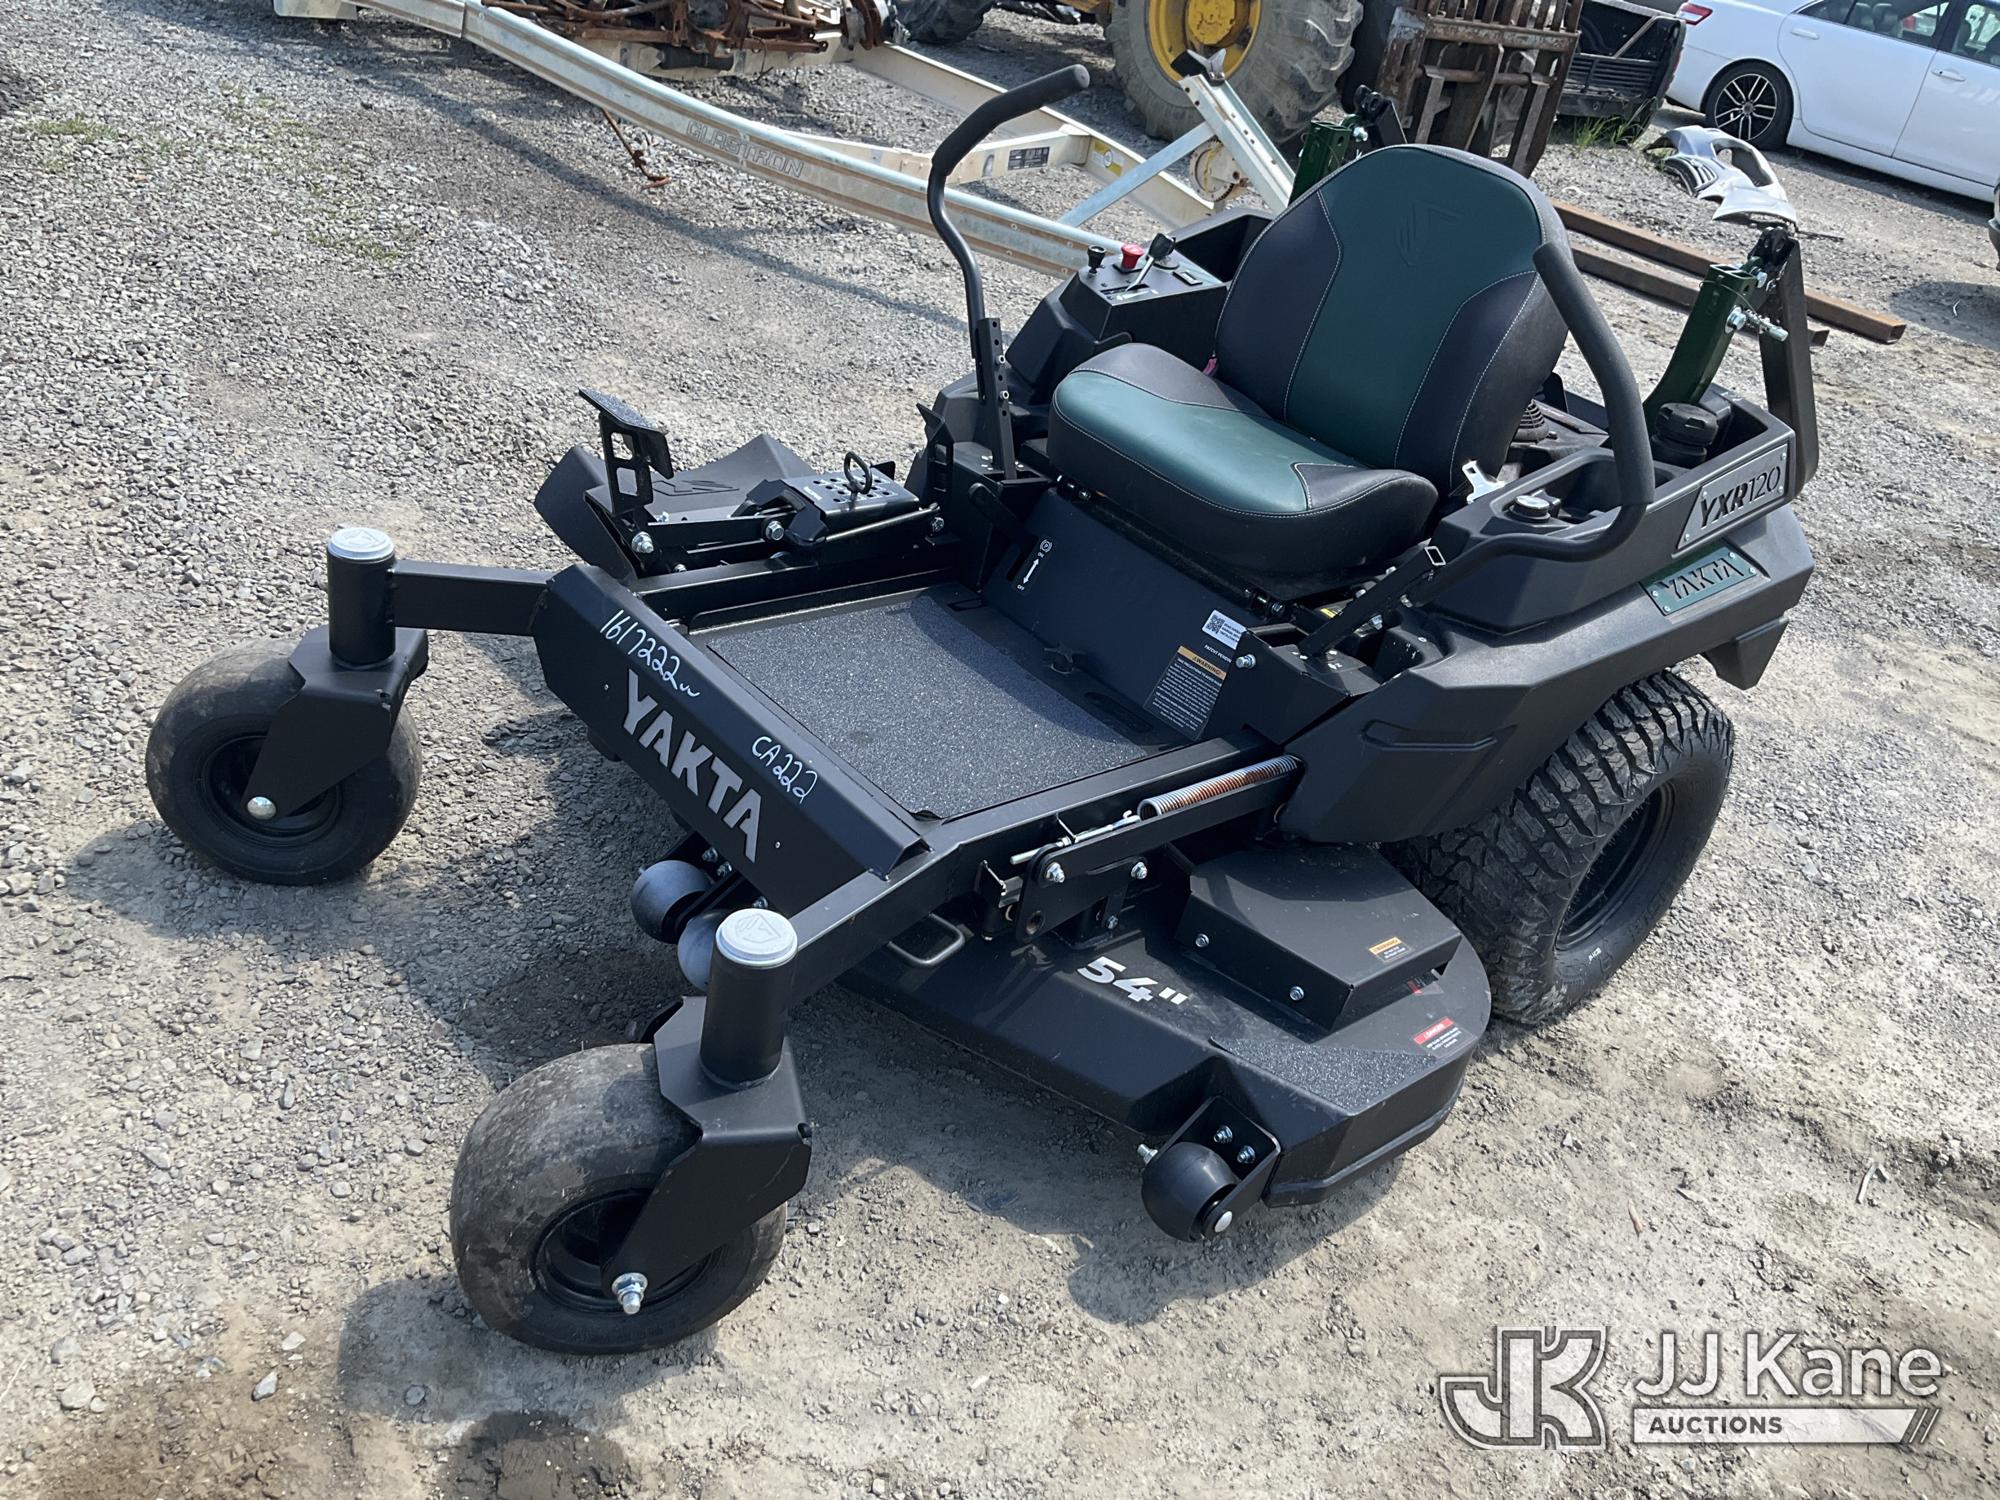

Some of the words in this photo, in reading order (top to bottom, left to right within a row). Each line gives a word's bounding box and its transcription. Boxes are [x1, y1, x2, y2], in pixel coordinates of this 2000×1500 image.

[686, 119, 805, 178] GLASTRON
[1700, 465, 1781, 530] YXR120
[1659, 557, 1745, 600] YAKTA
[623, 667, 762, 864] YAKTA
[751, 735, 818, 805] CA222
[1077, 955, 1189, 1006] 54"
